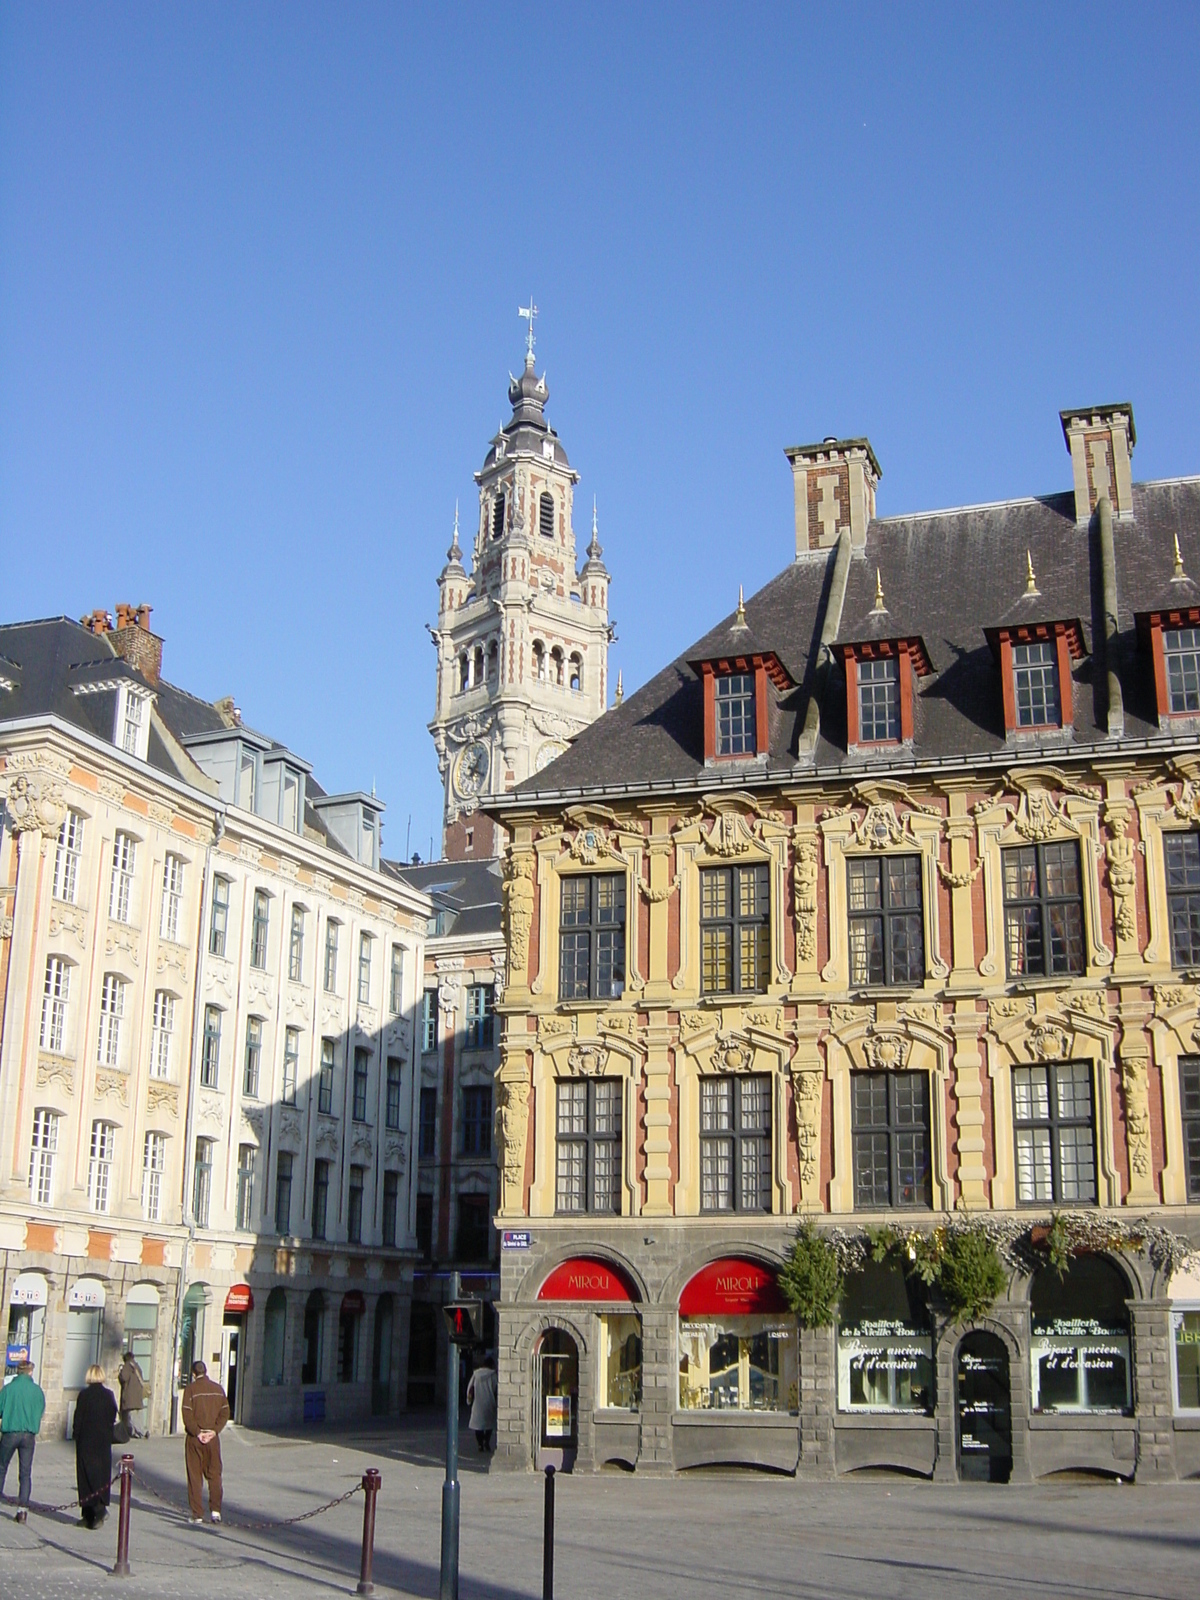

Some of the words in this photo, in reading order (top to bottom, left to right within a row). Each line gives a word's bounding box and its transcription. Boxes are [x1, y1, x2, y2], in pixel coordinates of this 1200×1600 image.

[512, 1233, 527, 1241] PLACE
[568, 1275, 609, 1290] MIROU
[715, 1276, 759, 1291] MIROU
[13, 1289, 40, 1303] LOTO
[72, 1292, 98, 1303] LOTO
[842, 1328, 852, 1337] de
[853, 1328, 861, 1337] la
[1034, 1326, 1046, 1336] de
[1046, 1326, 1055, 1336] la
